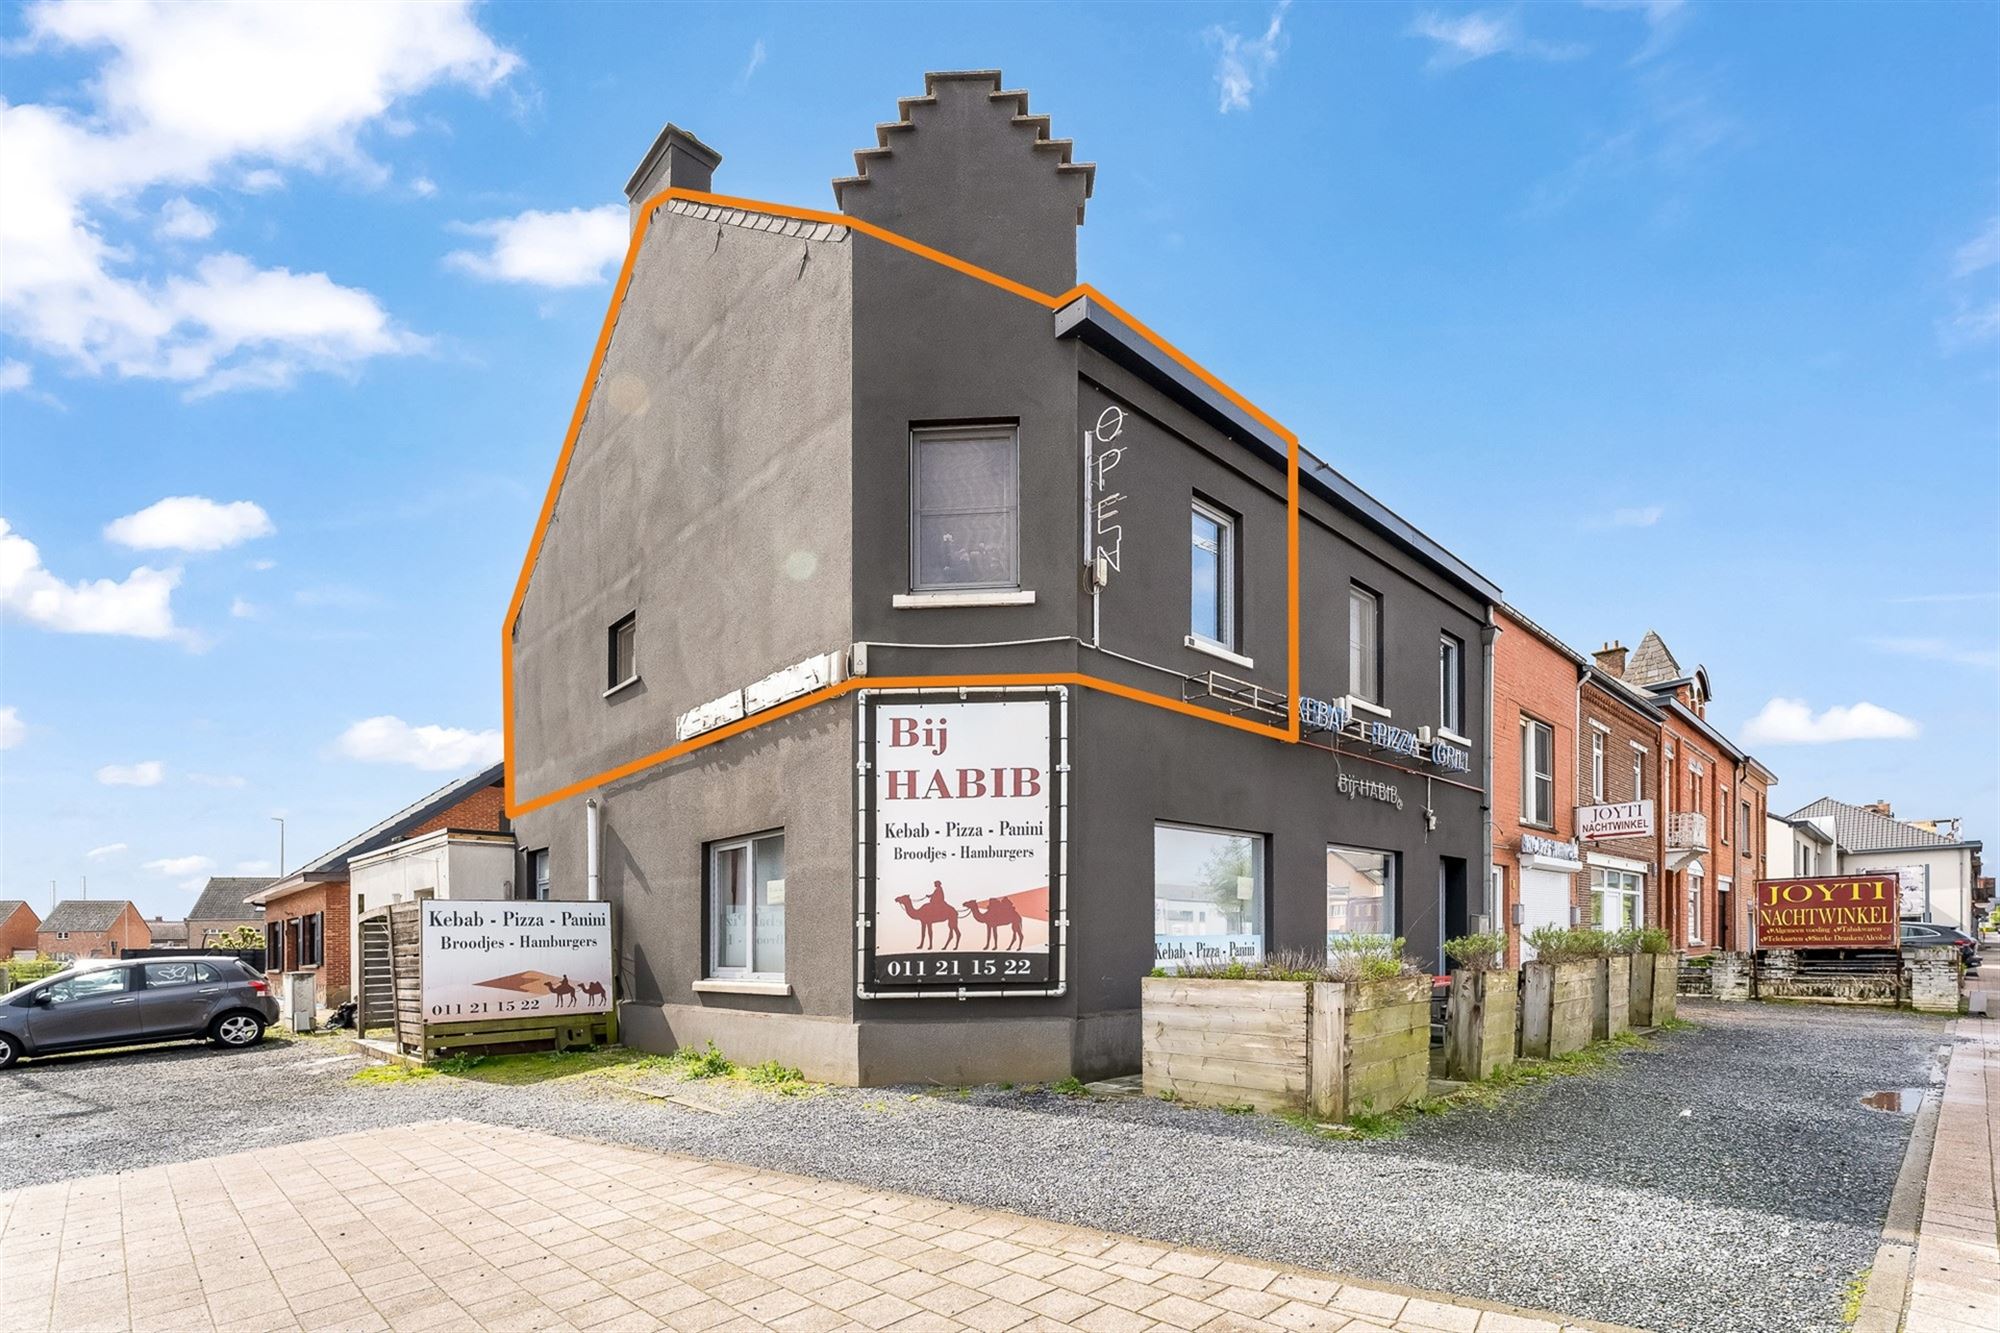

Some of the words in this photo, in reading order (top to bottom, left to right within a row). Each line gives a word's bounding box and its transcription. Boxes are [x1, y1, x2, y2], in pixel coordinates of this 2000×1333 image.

[889, 717, 948, 756] Bij
[1372, 721, 1420, 757] PIZZA
[885, 767, 1041, 800] HABIB
[1591, 804, 1643, 823] JOYTI
[884, 821, 930, 839] Kebab
[945, 821, 983, 838] Pizza
[999, 820, 1044, 837] Panini
[1582, 819, 1649, 833] NACHTWINKEL
[894, 847, 947, 863] Broodjes
[960, 845, 1035, 862] Hamburgers
[1763, 881, 1886, 907] JOYTI
[428, 910, 484, 928] Kebab
[503, 911, 544, 927] Pizza
[561, 911, 606, 927] Panini
[1760, 906, 1893, 926] NACHTWINKEL
[441, 935, 505, 952] Broodjes
[519, 935, 598, 950] Hamburgers
[1155, 942, 1185, 960] Kebab
[1196, 942, 1220, 958] Pizza
[1229, 941, 1255, 957] Panini
[887, 960, 926, 977] 011
[935, 960, 961, 976] 21
[971, 959, 997, 976] 15
[1004, 959, 1031, 975] 22
[432, 1004, 461, 1016] 011
[470, 1002, 488, 1014] 21
[499, 1001, 515, 1012] 15
[520, 1000, 540, 1011] 22
